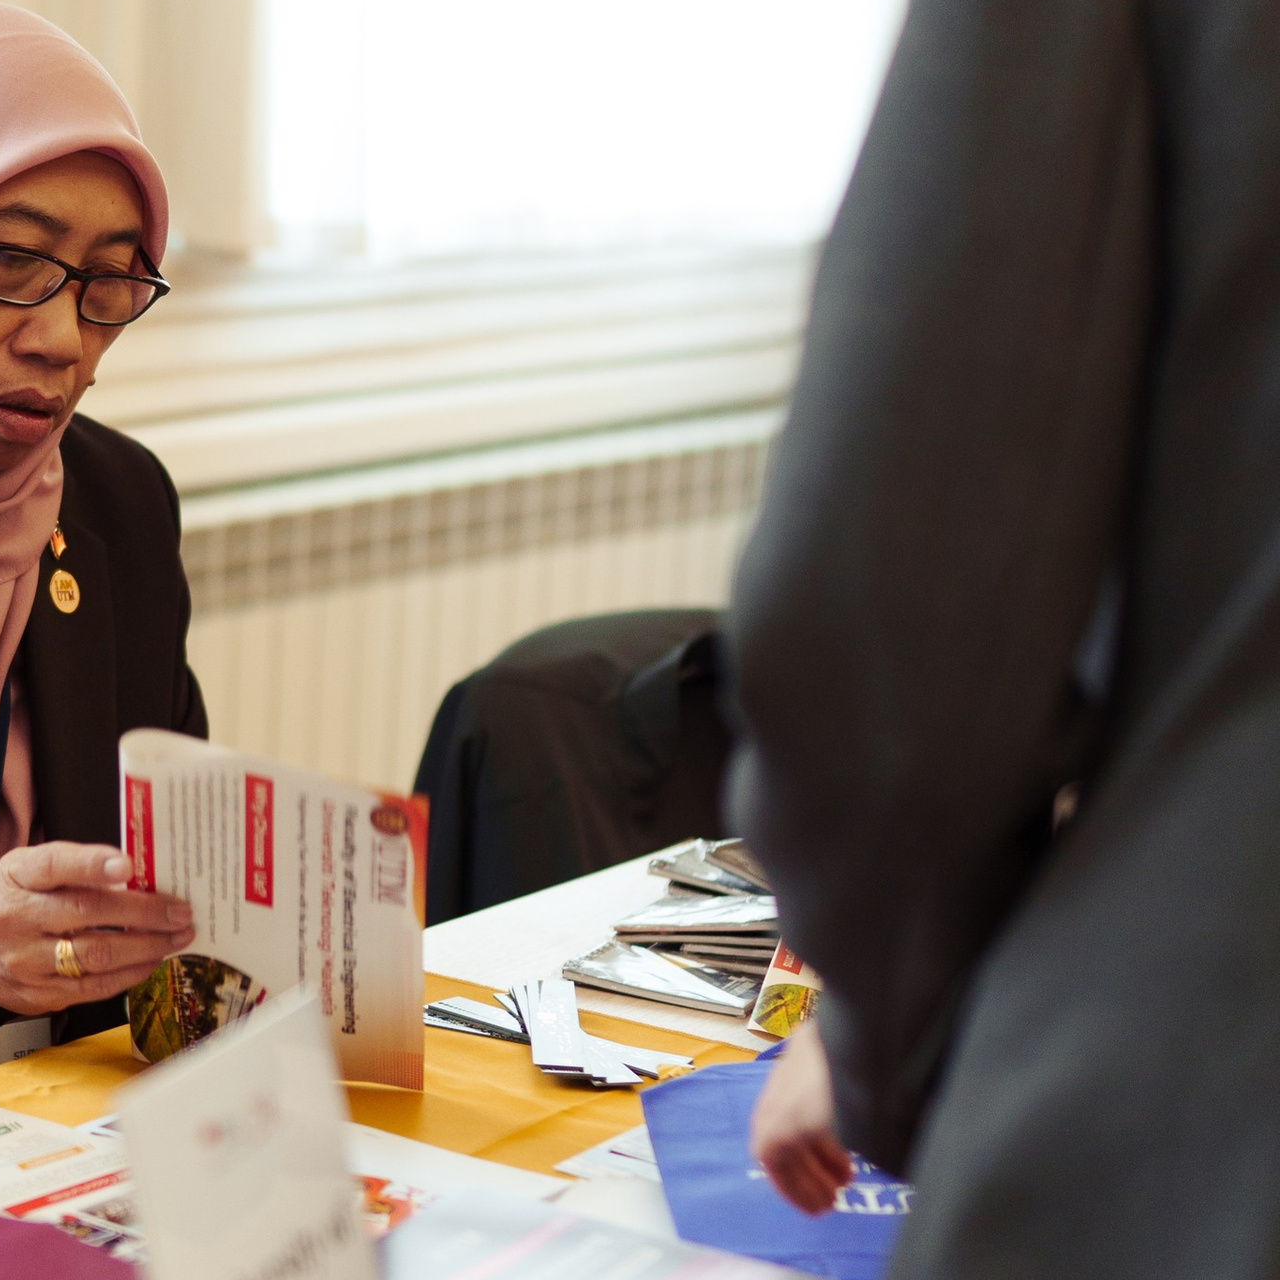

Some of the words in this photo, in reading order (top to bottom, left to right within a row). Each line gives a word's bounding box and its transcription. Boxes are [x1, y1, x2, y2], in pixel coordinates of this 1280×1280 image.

[60, 579, 74, 590] AM
[56, 591, 76, 602] UTM
[340, 958, 361, 1035] Engineering
